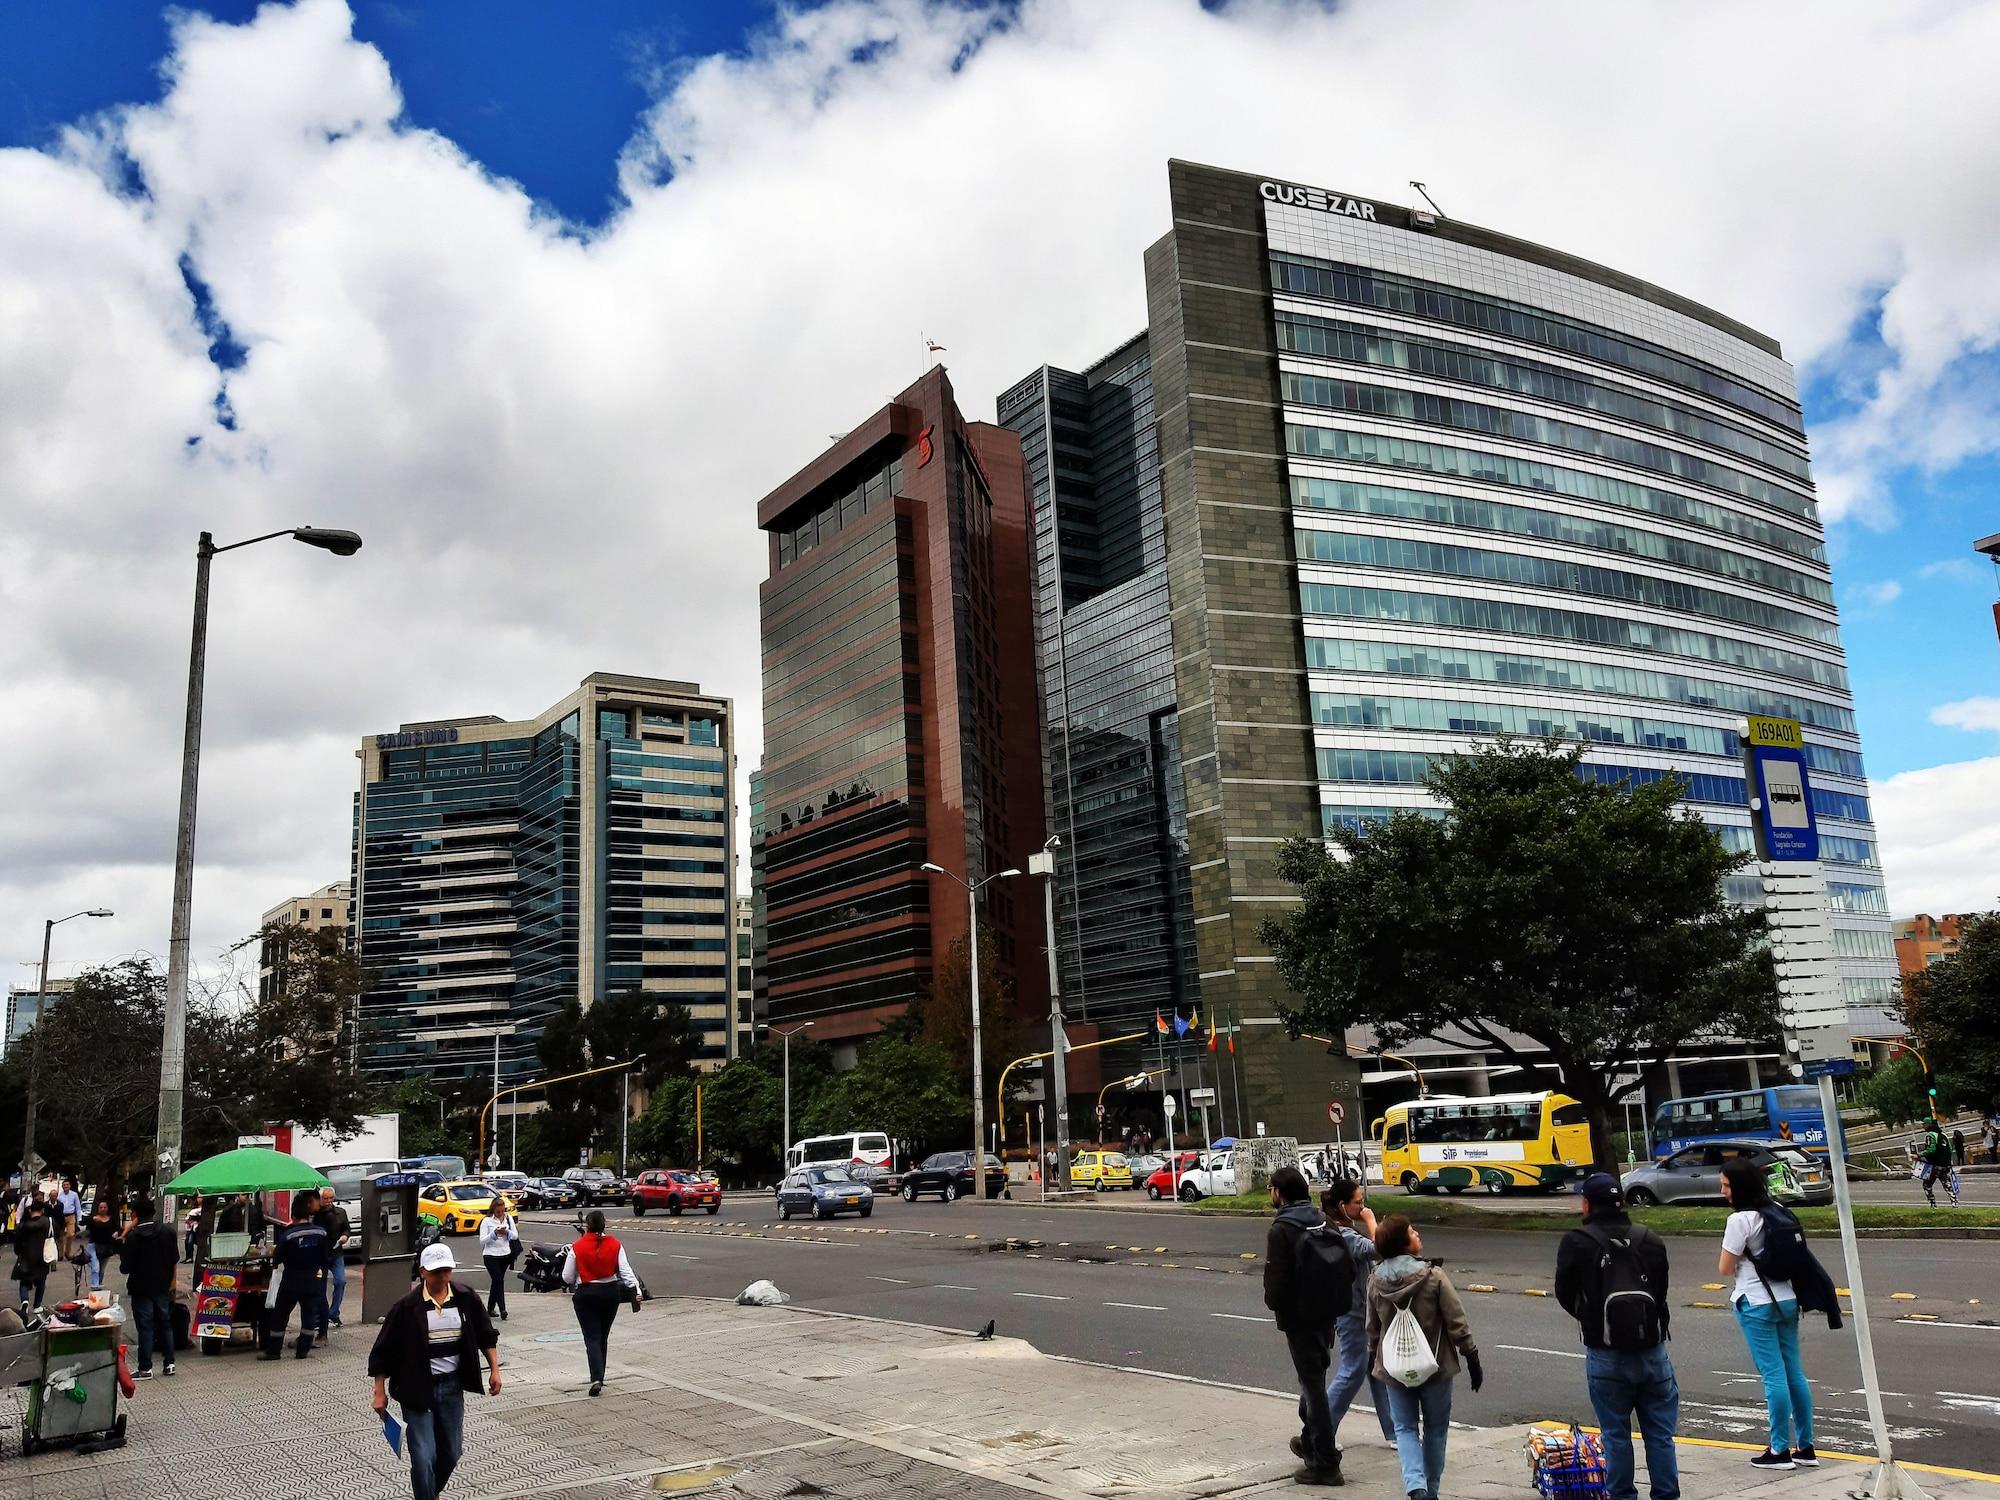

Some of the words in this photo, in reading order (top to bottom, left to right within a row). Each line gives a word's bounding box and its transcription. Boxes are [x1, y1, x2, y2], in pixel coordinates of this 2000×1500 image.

[1260, 182, 1377, 221] CUSEZAR
[376, 727, 457, 749] SAMSUNG
[1756, 722, 1795, 742] 169A01
